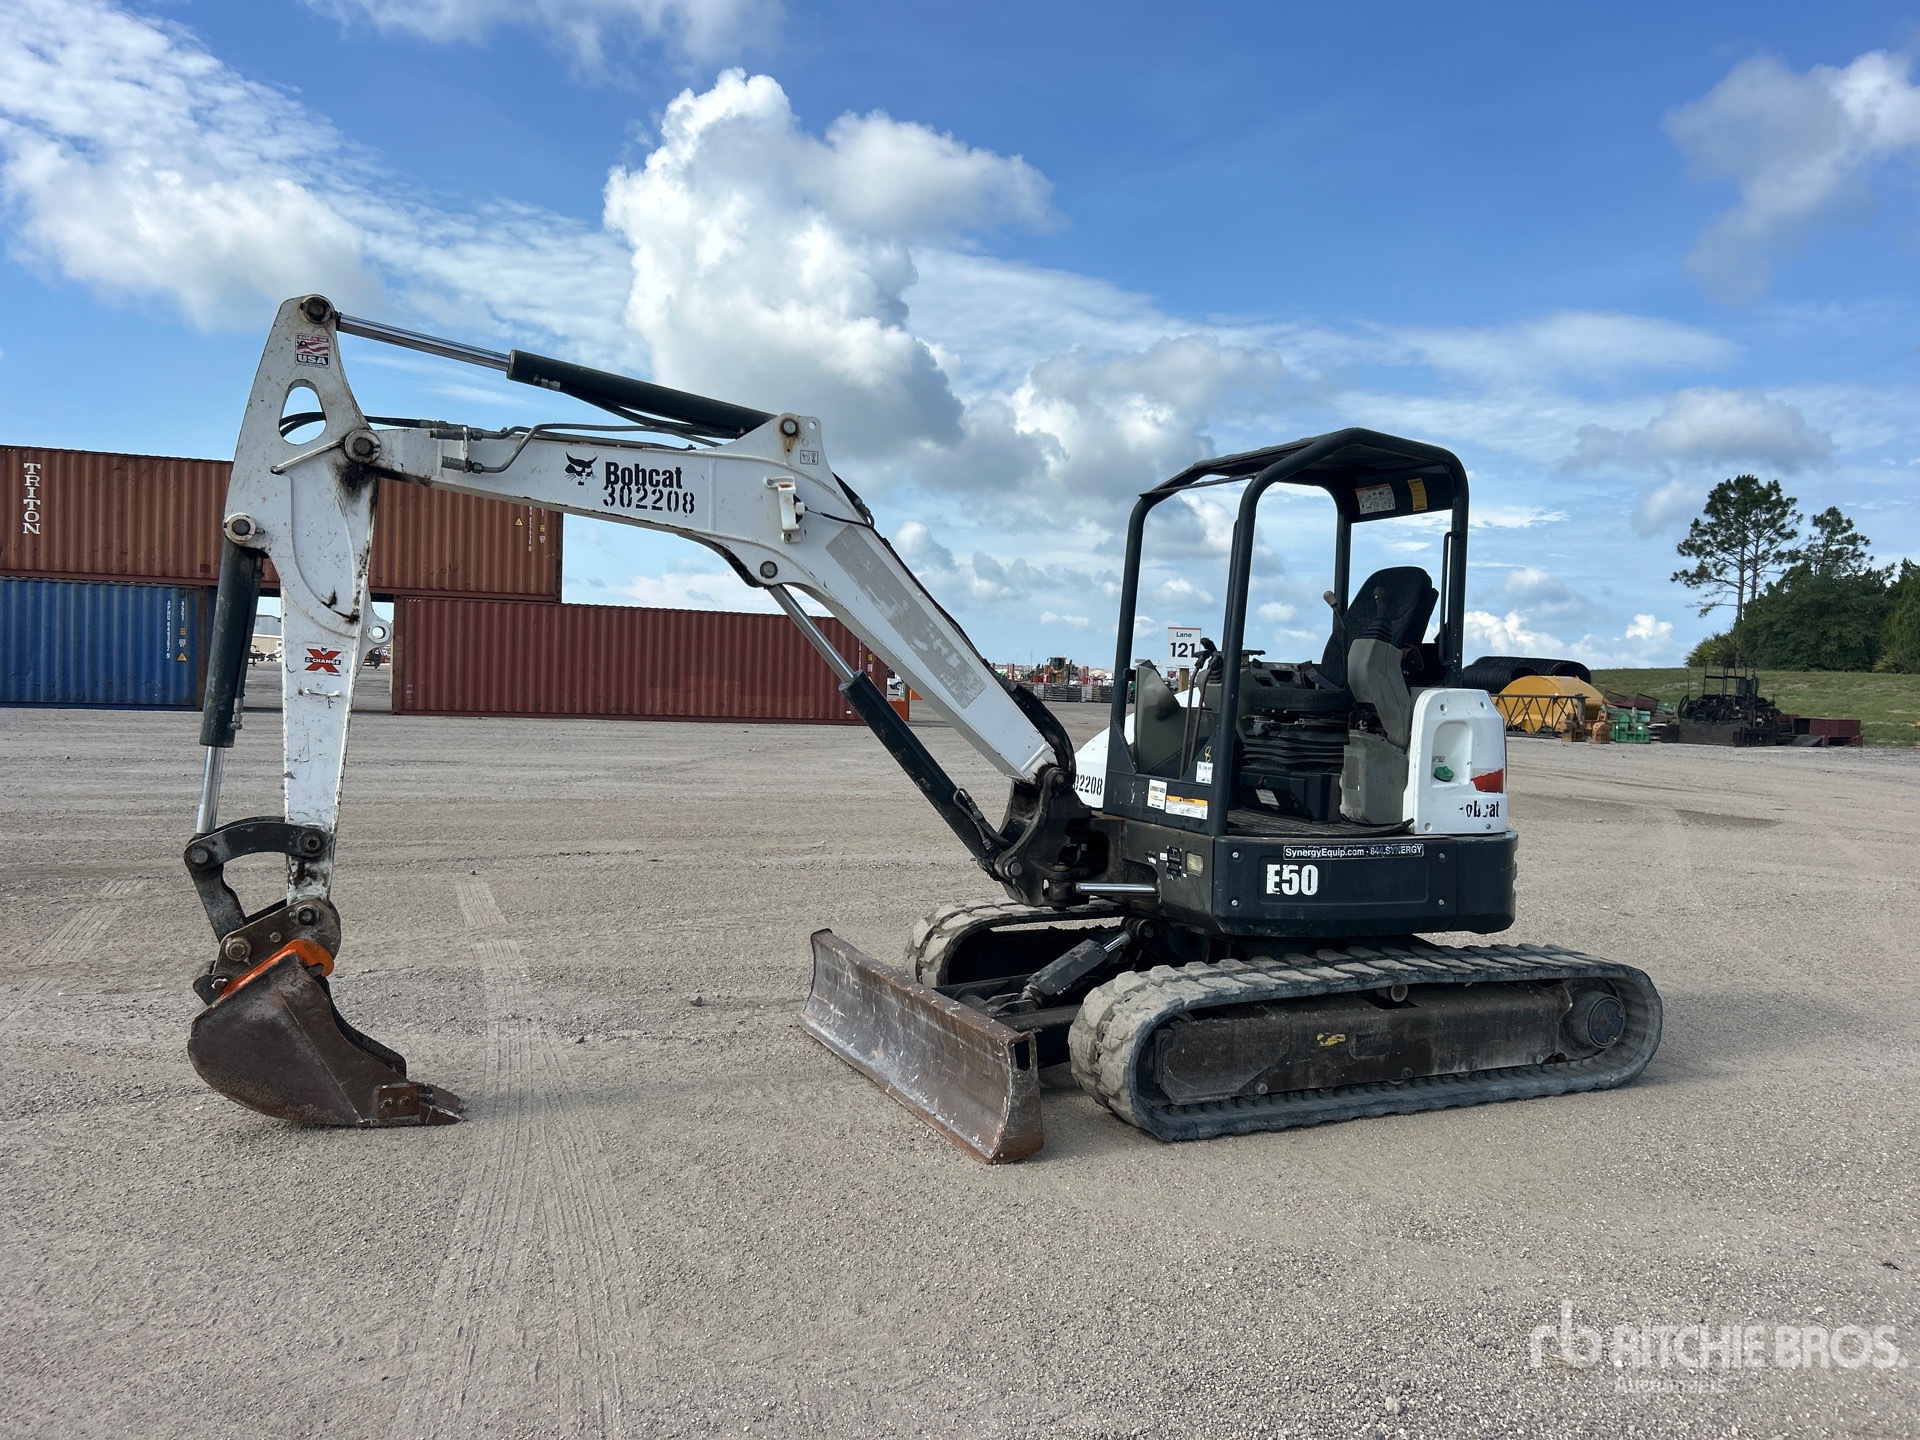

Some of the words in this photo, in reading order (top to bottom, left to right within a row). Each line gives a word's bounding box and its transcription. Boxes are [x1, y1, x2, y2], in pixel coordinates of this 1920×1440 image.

[297, 354, 328, 365] USA
[605, 461, 682, 489] Bobcat
[23, 462, 41, 535] TRITON
[602, 483, 695, 514] 302208
[1170, 642, 1195, 658] 121
[1459, 800, 1499, 818] obat
[1285, 847, 1365, 858] SynergyEquip.com
[1266, 864, 1319, 896] E50
